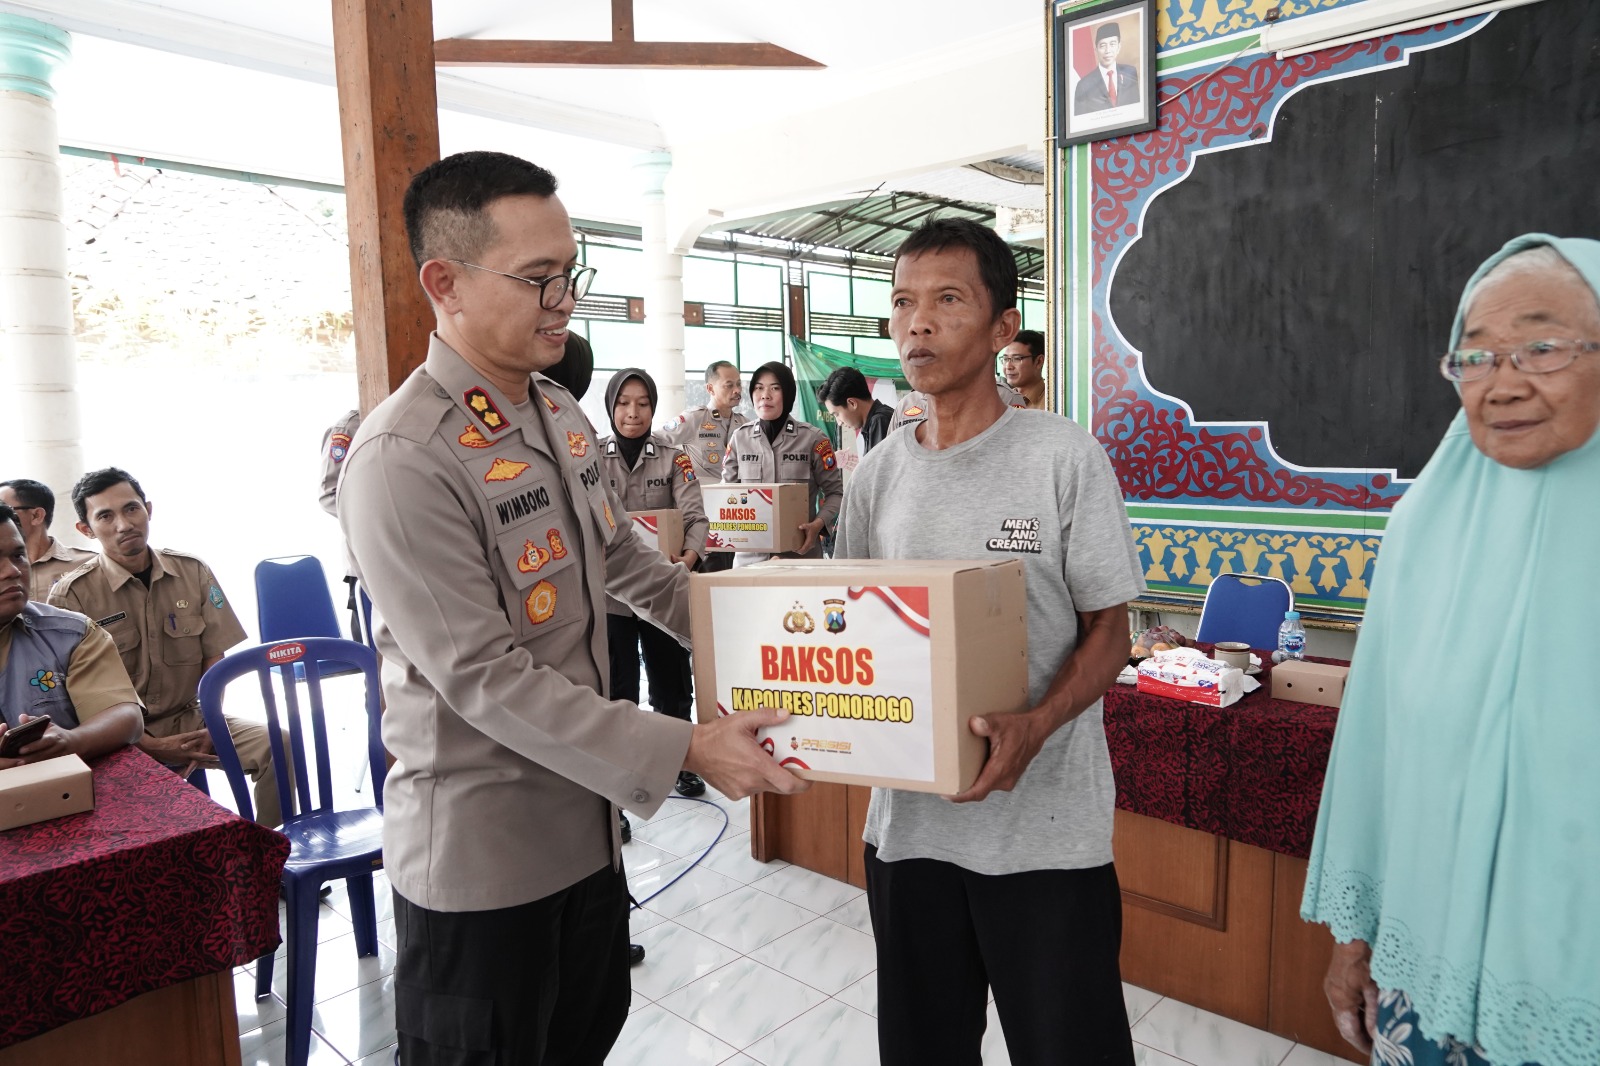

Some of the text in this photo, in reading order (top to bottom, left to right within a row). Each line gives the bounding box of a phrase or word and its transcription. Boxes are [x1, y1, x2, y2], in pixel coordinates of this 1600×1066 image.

[783, 453, 808, 462] POLRI
[580, 459, 600, 491] POL
[496, 486, 550, 525] WIMBOKO
[720, 508, 756, 521] BAKSOS
[709, 522, 768, 532] KAPOLRES PONOROGO
[1001, 517, 1040, 531] MEN'S
[1008, 529, 1038, 541] AND
[986, 538, 1042, 554] CREATIVE.
[269, 646, 302, 660] NIKITA
[760, 644, 875, 687] BAKSOS
[731, 687, 914, 724] KAPOLRES PONOROGO
